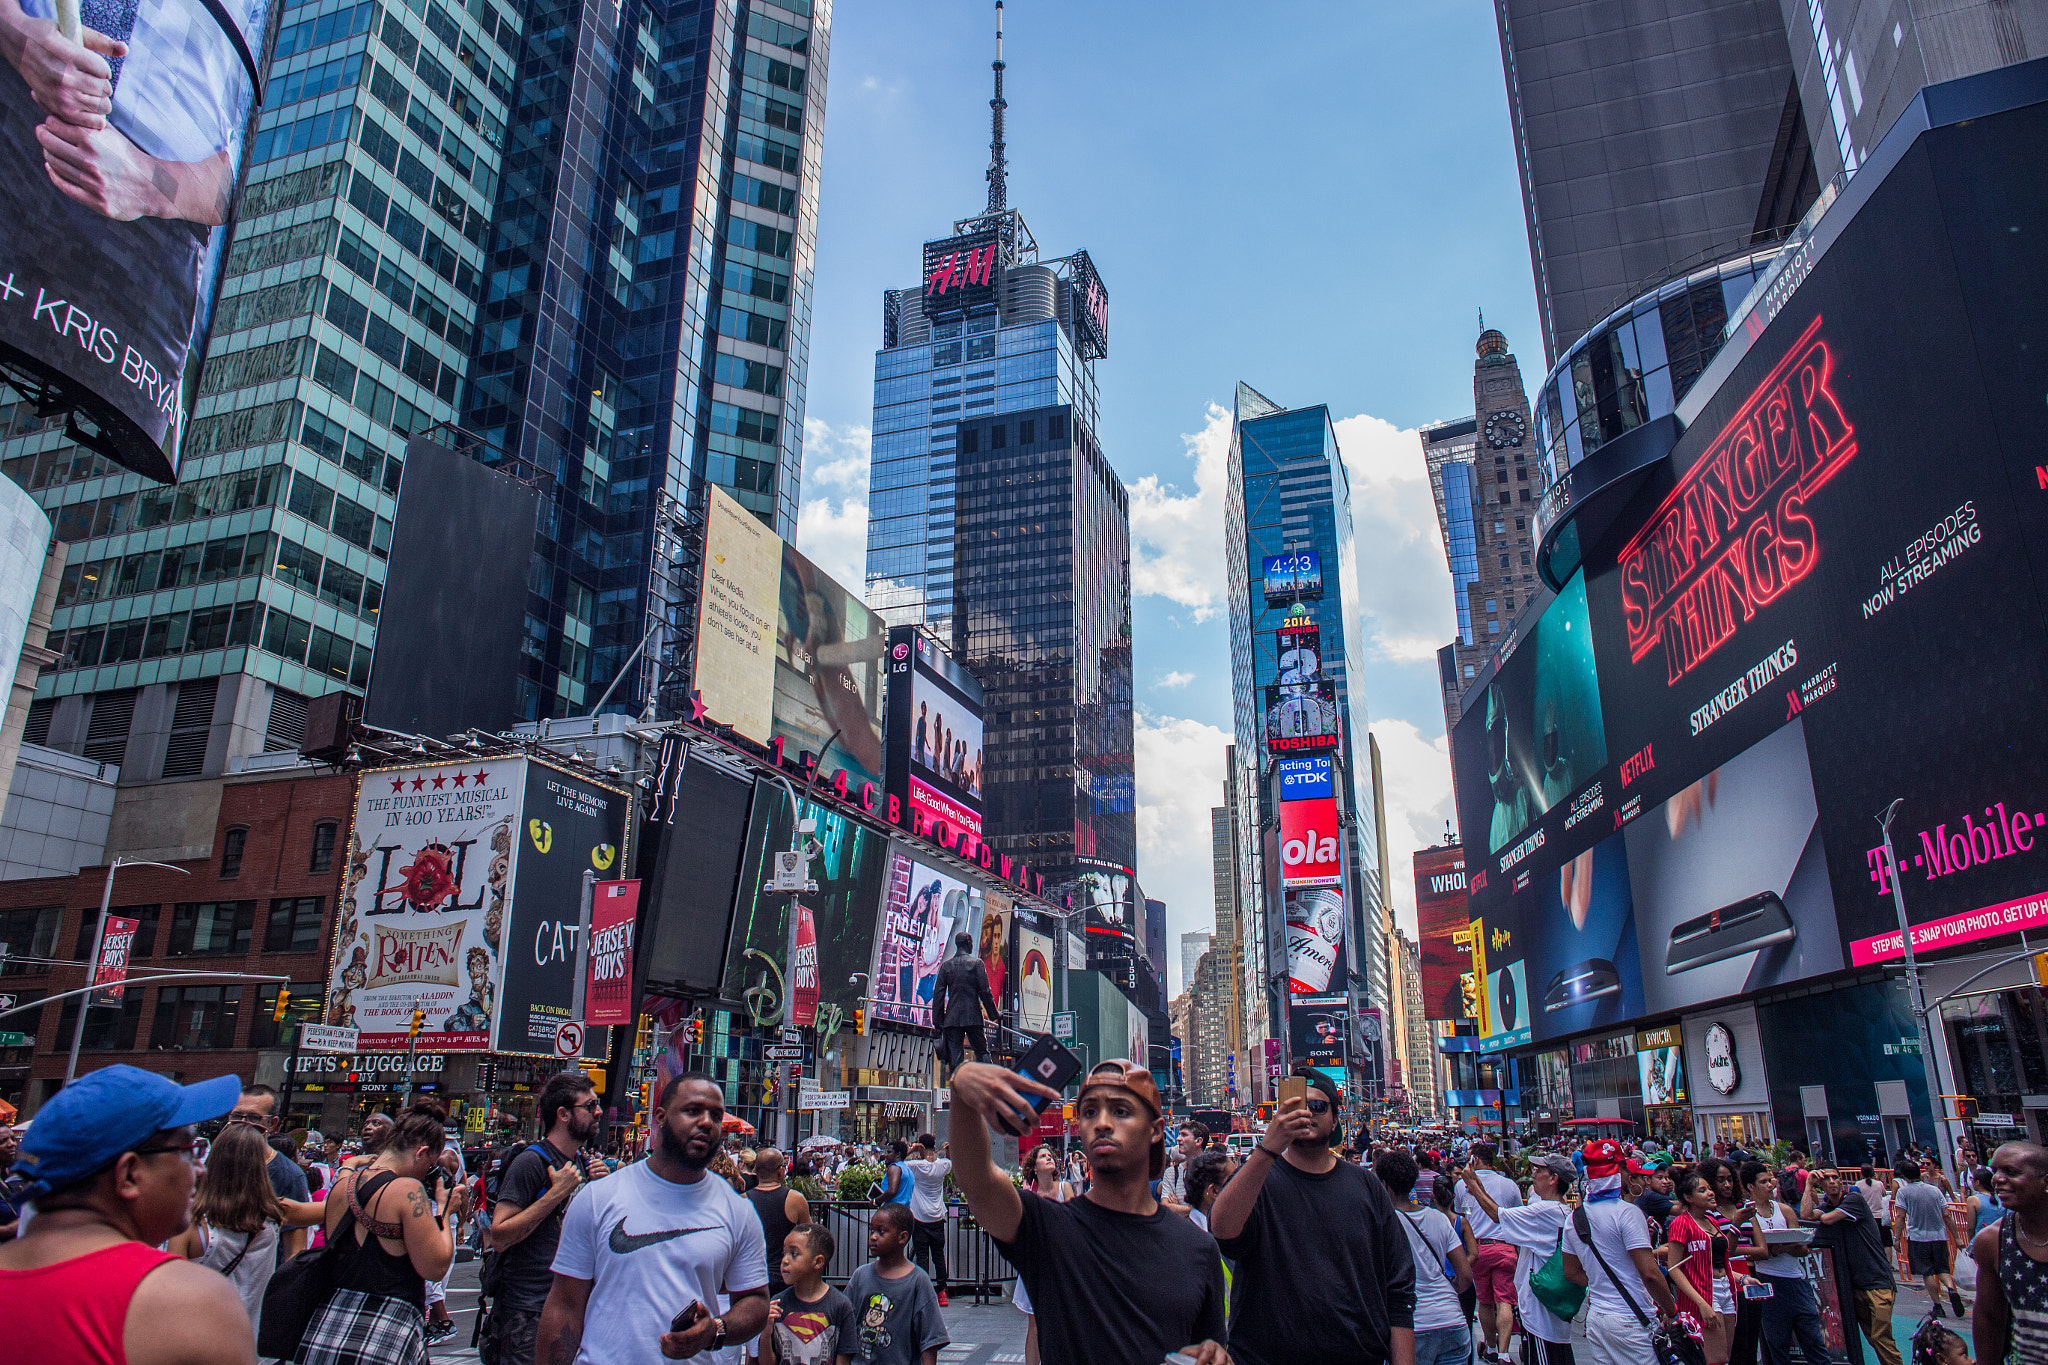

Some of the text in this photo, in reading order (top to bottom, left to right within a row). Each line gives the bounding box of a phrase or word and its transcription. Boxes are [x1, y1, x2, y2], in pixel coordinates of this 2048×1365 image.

[927, 243, 996, 296] H&M
[1765, 235, 1815, 307] MARRIOTT
[1768, 261, 1813, 322] MARQUIS
[1086, 277, 1108, 340] H&M
[32, 287, 118, 364] KRIS
[120, 344, 189, 436] BRYANT
[1620, 340, 1854, 650] STRANGER
[1880, 500, 1977, 585] ALL EPISODES
[1271, 555, 1312, 574] 4:23
[1862, 522, 1982, 619] NOW STREAMING
[711, 568, 745, 600] Dear Media,
[1654, 481, 1817, 687] THINGS
[710, 584, 771, 632] When you focus on an
[709, 601, 762, 641] athlete's looks, you
[1277, 625, 1319, 636] TOSHIBA
[1283, 615, 1312, 628] 2016
[707, 616, 723, 633] don't
[724, 627, 735, 640] see
[735, 632, 745, 645] her
[745, 640, 752, 651] at
[923, 642, 931, 657] LG
[893, 662, 907, 673] LG
[1801, 662, 1838, 693] MARRIOTT
[1689, 638, 1798, 737] STRANGER THINGS
[1803, 677, 1837, 706] MARQUIS
[1270, 734, 1338, 751] TOSHIBA
[1620, 742, 1656, 789] NETFLIX
[1294, 772, 1328, 784] TDK
[368, 787, 509, 811] THE FUNNIEST MUSICAL
[547, 780, 608, 810] LET THE MEMORY
[556, 795, 598, 818] LIVE AGAIN
[913, 785, 926, 803] Life's
[926, 793, 941, 812] Good
[940, 800, 956, 820] When
[955, 809, 966, 826] You
[1570, 781, 1603, 814] ALL EPISODES
[385, 810, 433, 827] IN 400
[1564, 794, 1604, 831] NOW STREAMING
[887, 793, 1043, 895] BROADWAY
[1499, 827, 1546, 874] STRANGER THINGS
[1078, 857, 1093, 865] THEY
[1094, 859, 1107, 868] FALL
[1470, 868, 1488, 897] NETFLIX
[386, 928, 452, 940] SOMETHING
[591, 921, 634, 957] JERSEY
[1871, 901, 2039, 955] STEP SNAP YOUR PHOTO. GET UP
[103, 933, 134, 950] JERSEY
[535, 920, 592, 966] CAT
[103, 950, 125, 967] BOYS
[594, 951, 626, 981] BOYS
[796, 966, 816, 988] BOYS
[419, 991, 455, 1000] ALADDIN
[363, 1008, 379, 1016] THE
[381, 1008, 403, 1016] BOOK
[530, 1003, 555, 1014] BACK ON
[2, 1033, 7, 1042] 7
[307, 1027, 356, 1040] PEDESTRIAN FLOW ZONE
[328, 1039, 355, 1049] KEEP MOVING
[1645, 1028, 1672, 1047] INVICTA
[867, 1028, 935, 1074] FOREVER
[1902, 1045, 1912, 1054] 46
[305, 1083, 325, 1092] Nikon
[329, 1084, 354, 1092] Canon
[357, 1072, 374, 1082] NY
[361, 1084, 388, 1092] SONY
[467, 1108, 475, 1128] ATM
[883, 1102, 910, 1118] FOREVER
[1687, 1239, 1706, 1253] NEW
